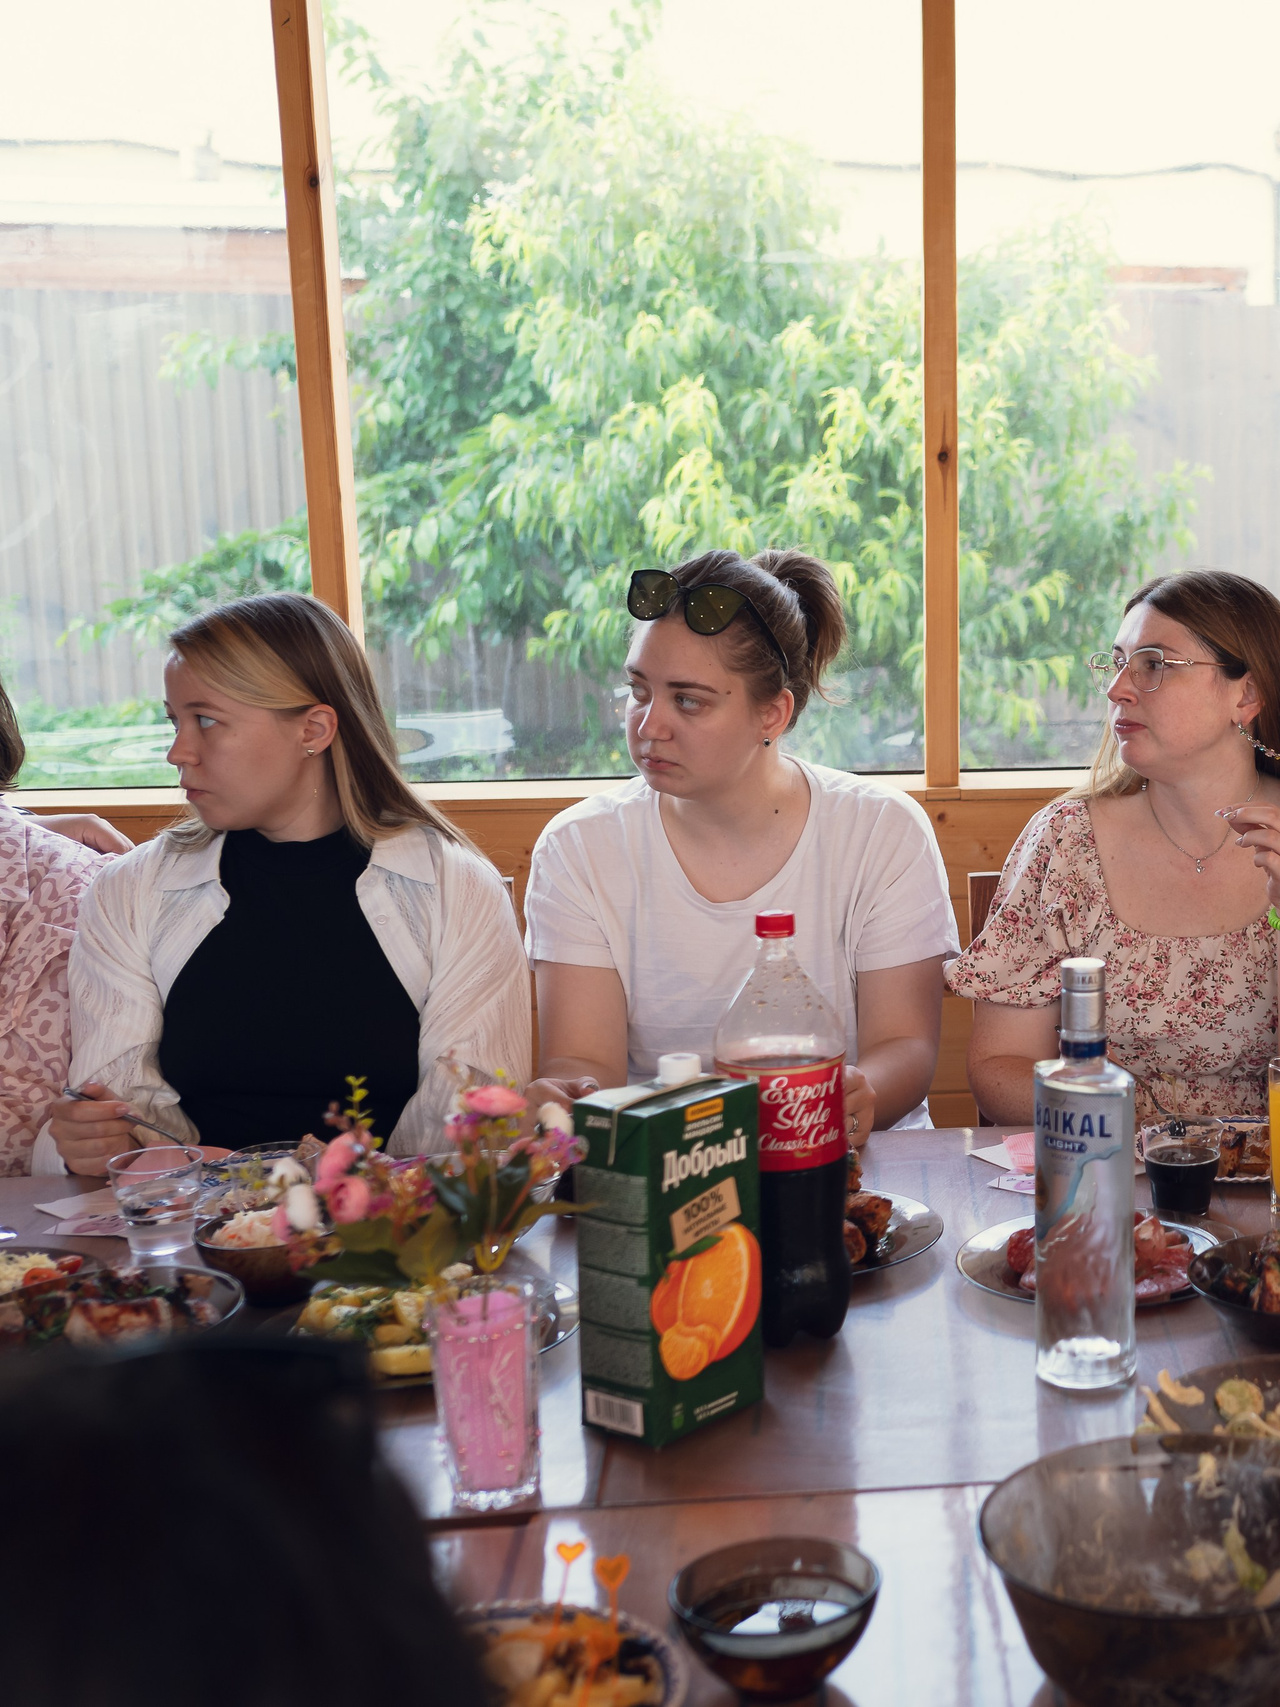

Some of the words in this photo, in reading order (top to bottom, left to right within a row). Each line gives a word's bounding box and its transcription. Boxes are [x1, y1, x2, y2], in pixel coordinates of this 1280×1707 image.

[760, 1067, 839, 1116] Export
[772, 1101, 831, 1136] Style
[757, 1133, 807, 1152] Classic
[807, 1124, 840, 1149] Cola
[1047, 1137, 1081, 1151] LIGHT
[661, 1128, 747, 1194] Добрый
[684, 1186, 724, 1222] 100%
